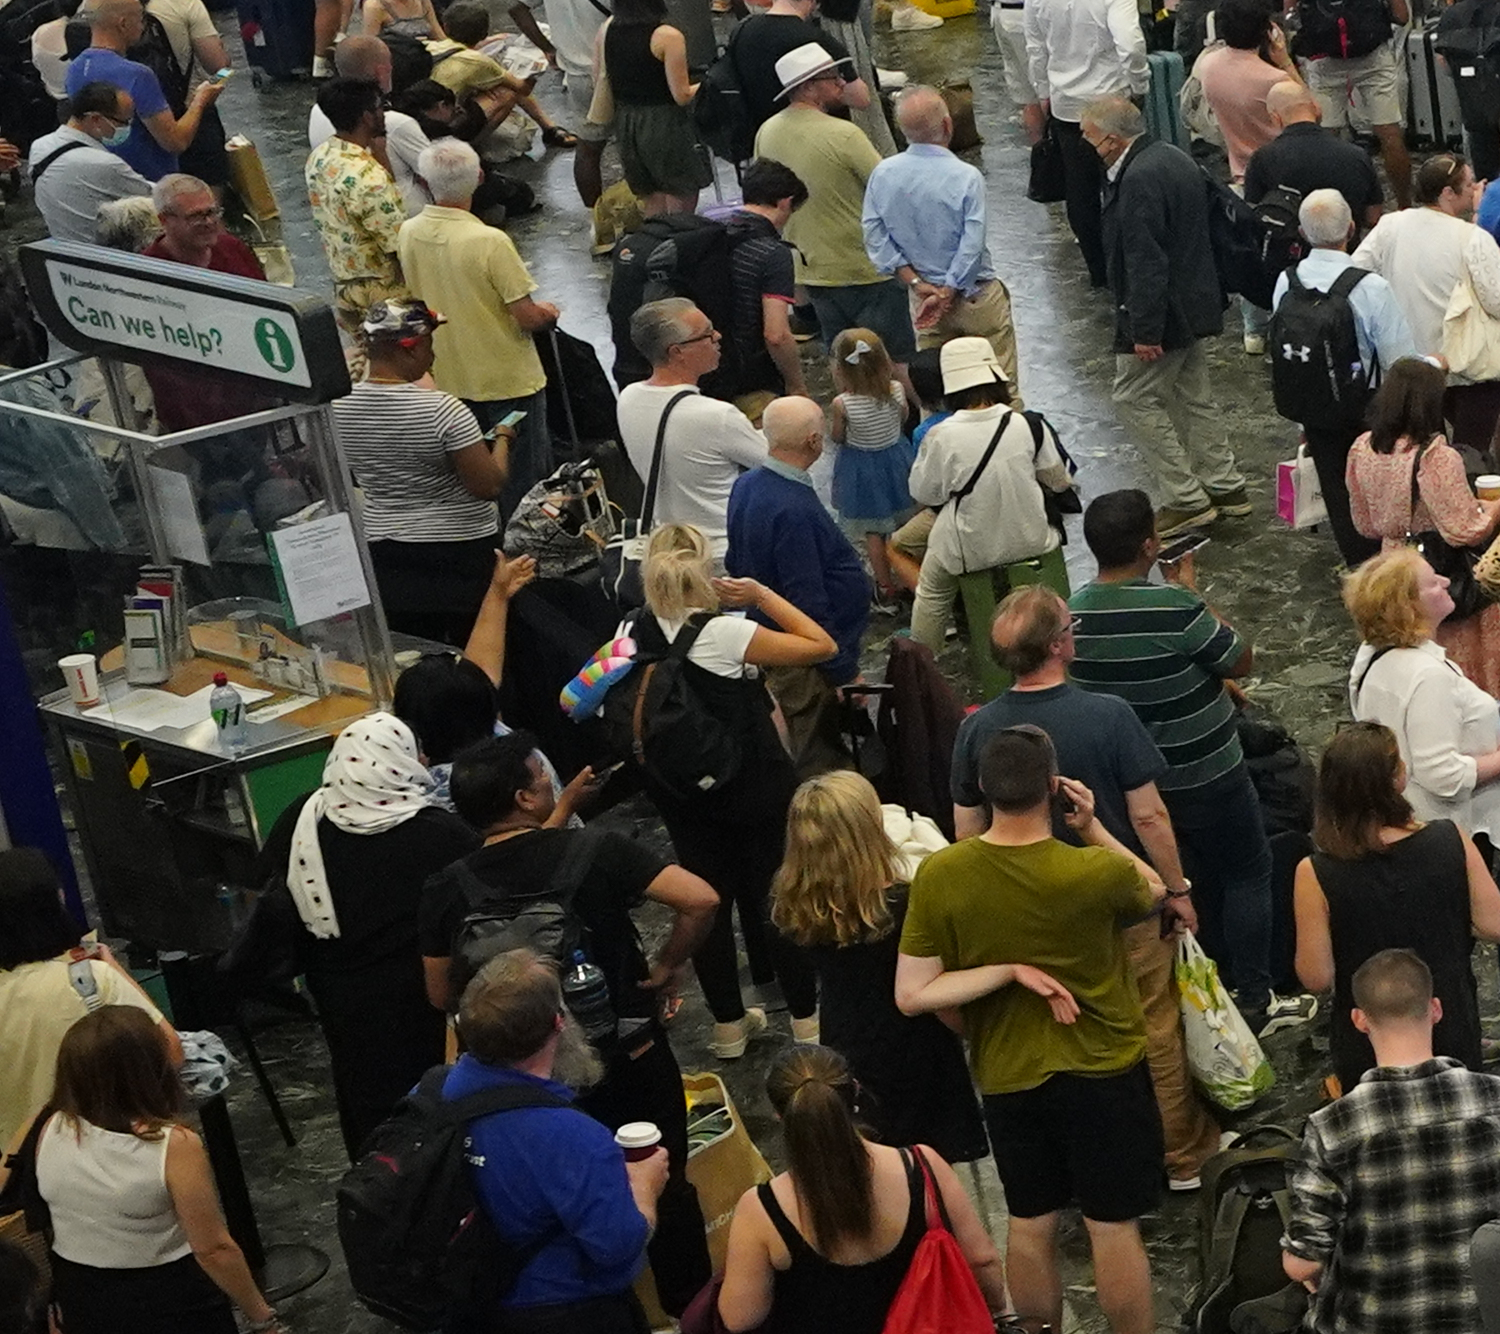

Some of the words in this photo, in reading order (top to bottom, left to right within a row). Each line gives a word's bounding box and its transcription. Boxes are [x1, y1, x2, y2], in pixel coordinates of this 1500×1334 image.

[69, 297, 117, 329] Can
[125, 314, 157, 338] we
[162, 319, 223, 357] help?
